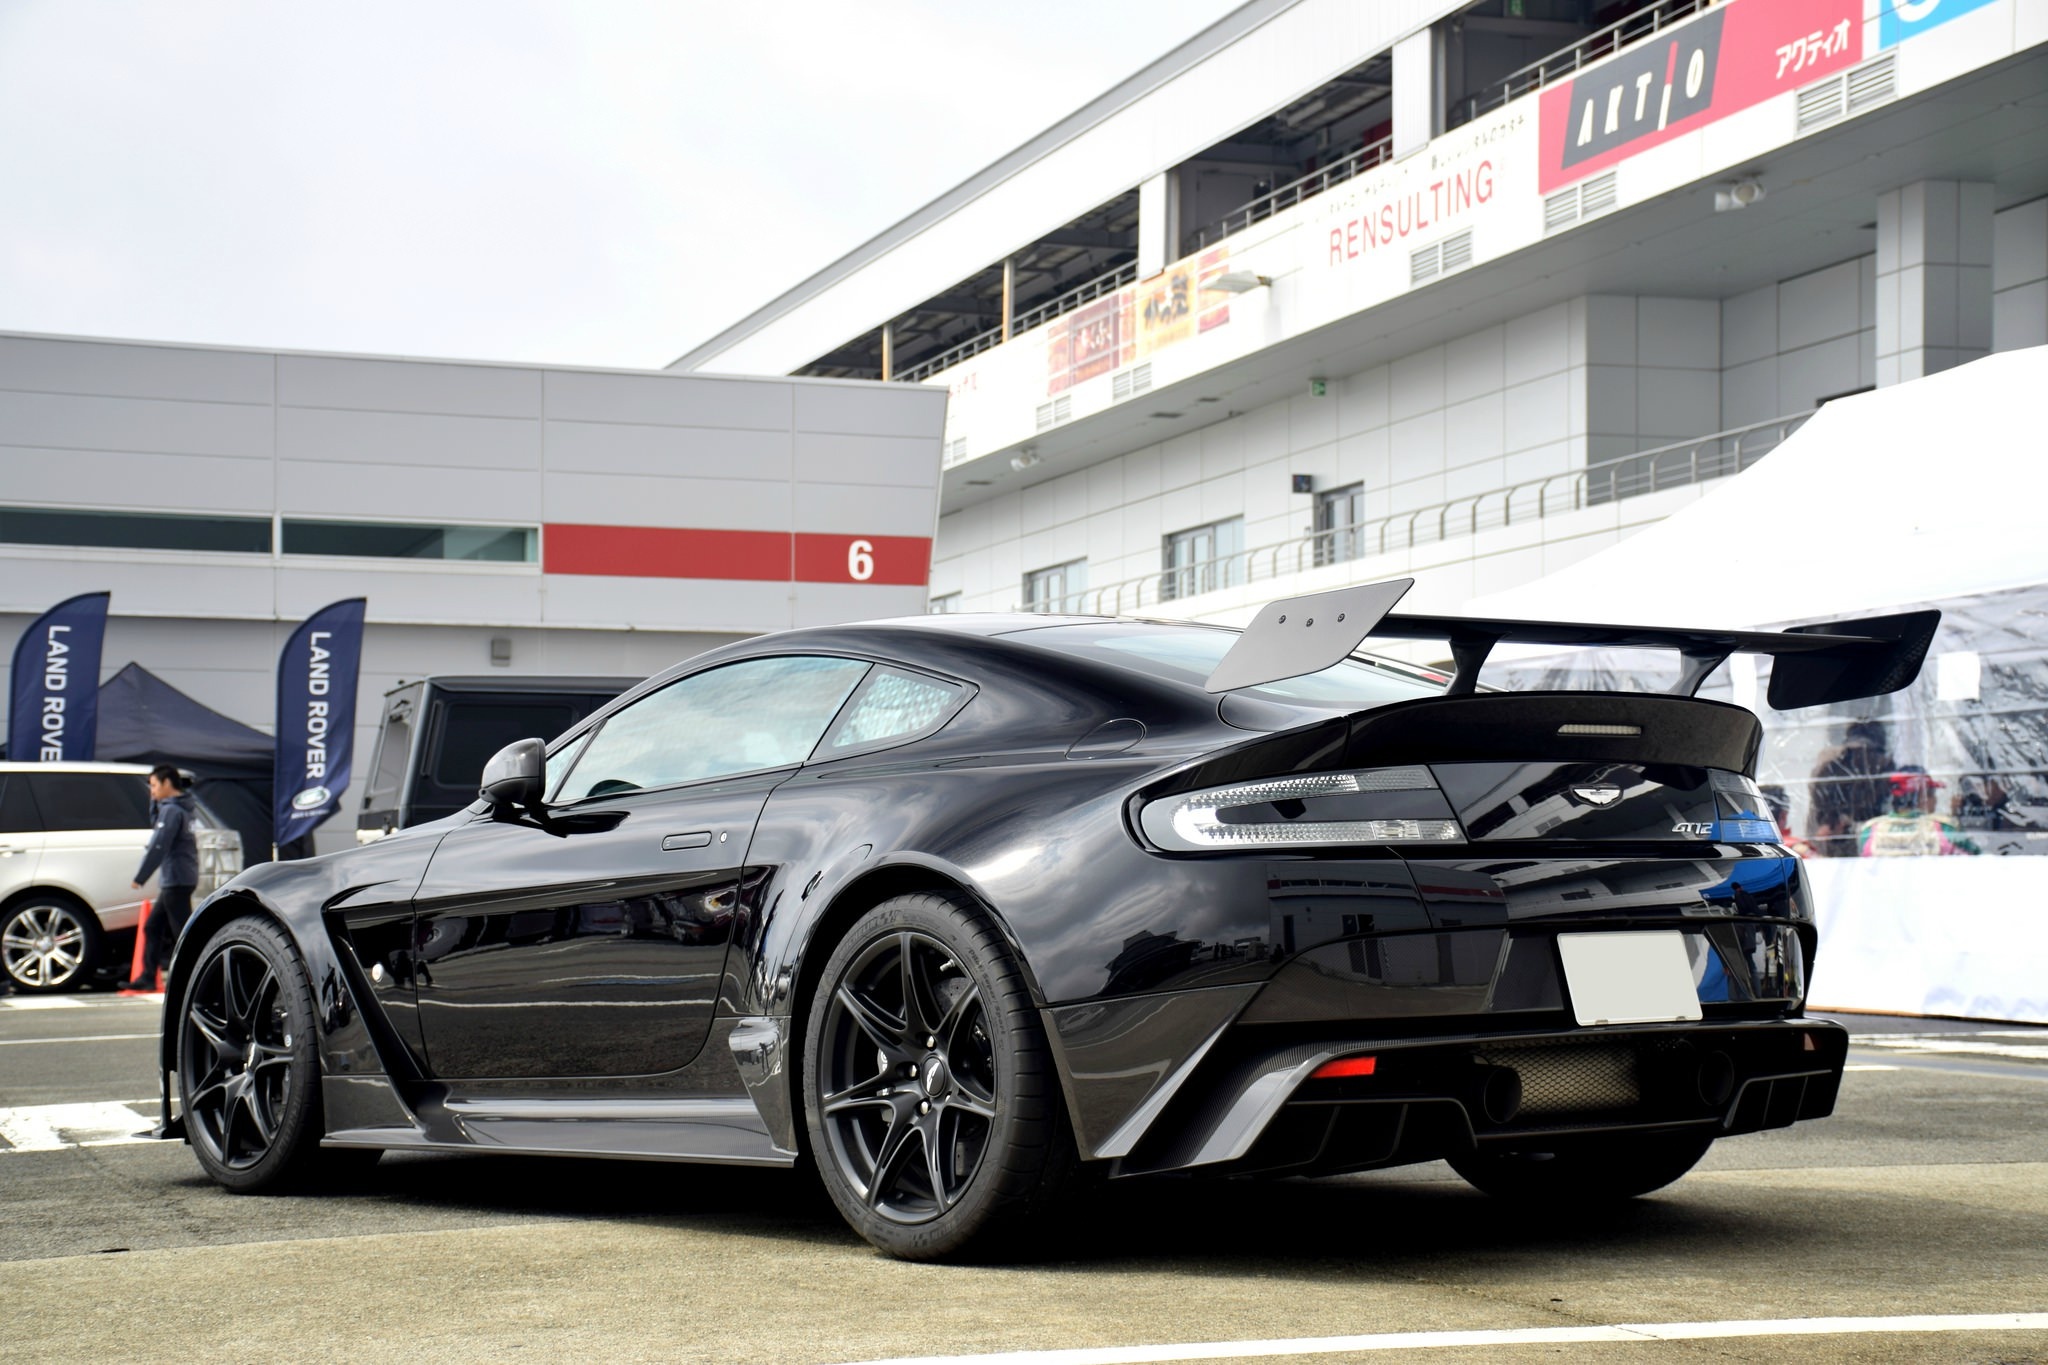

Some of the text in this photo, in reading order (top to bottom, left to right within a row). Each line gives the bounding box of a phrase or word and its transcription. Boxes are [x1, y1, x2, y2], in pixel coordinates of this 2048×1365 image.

[1577, 40, 1704, 147] AKTIO
[1775, 18, 1851, 80] アクティオ
[1329, 159, 1494, 267] RENSULTING
[848, 540, 874, 581] 6
[40, 625, 72, 762] LAND ROVE
[306, 632, 332, 779] LAND ROVER
[1672, 822, 1714, 834] GT12
